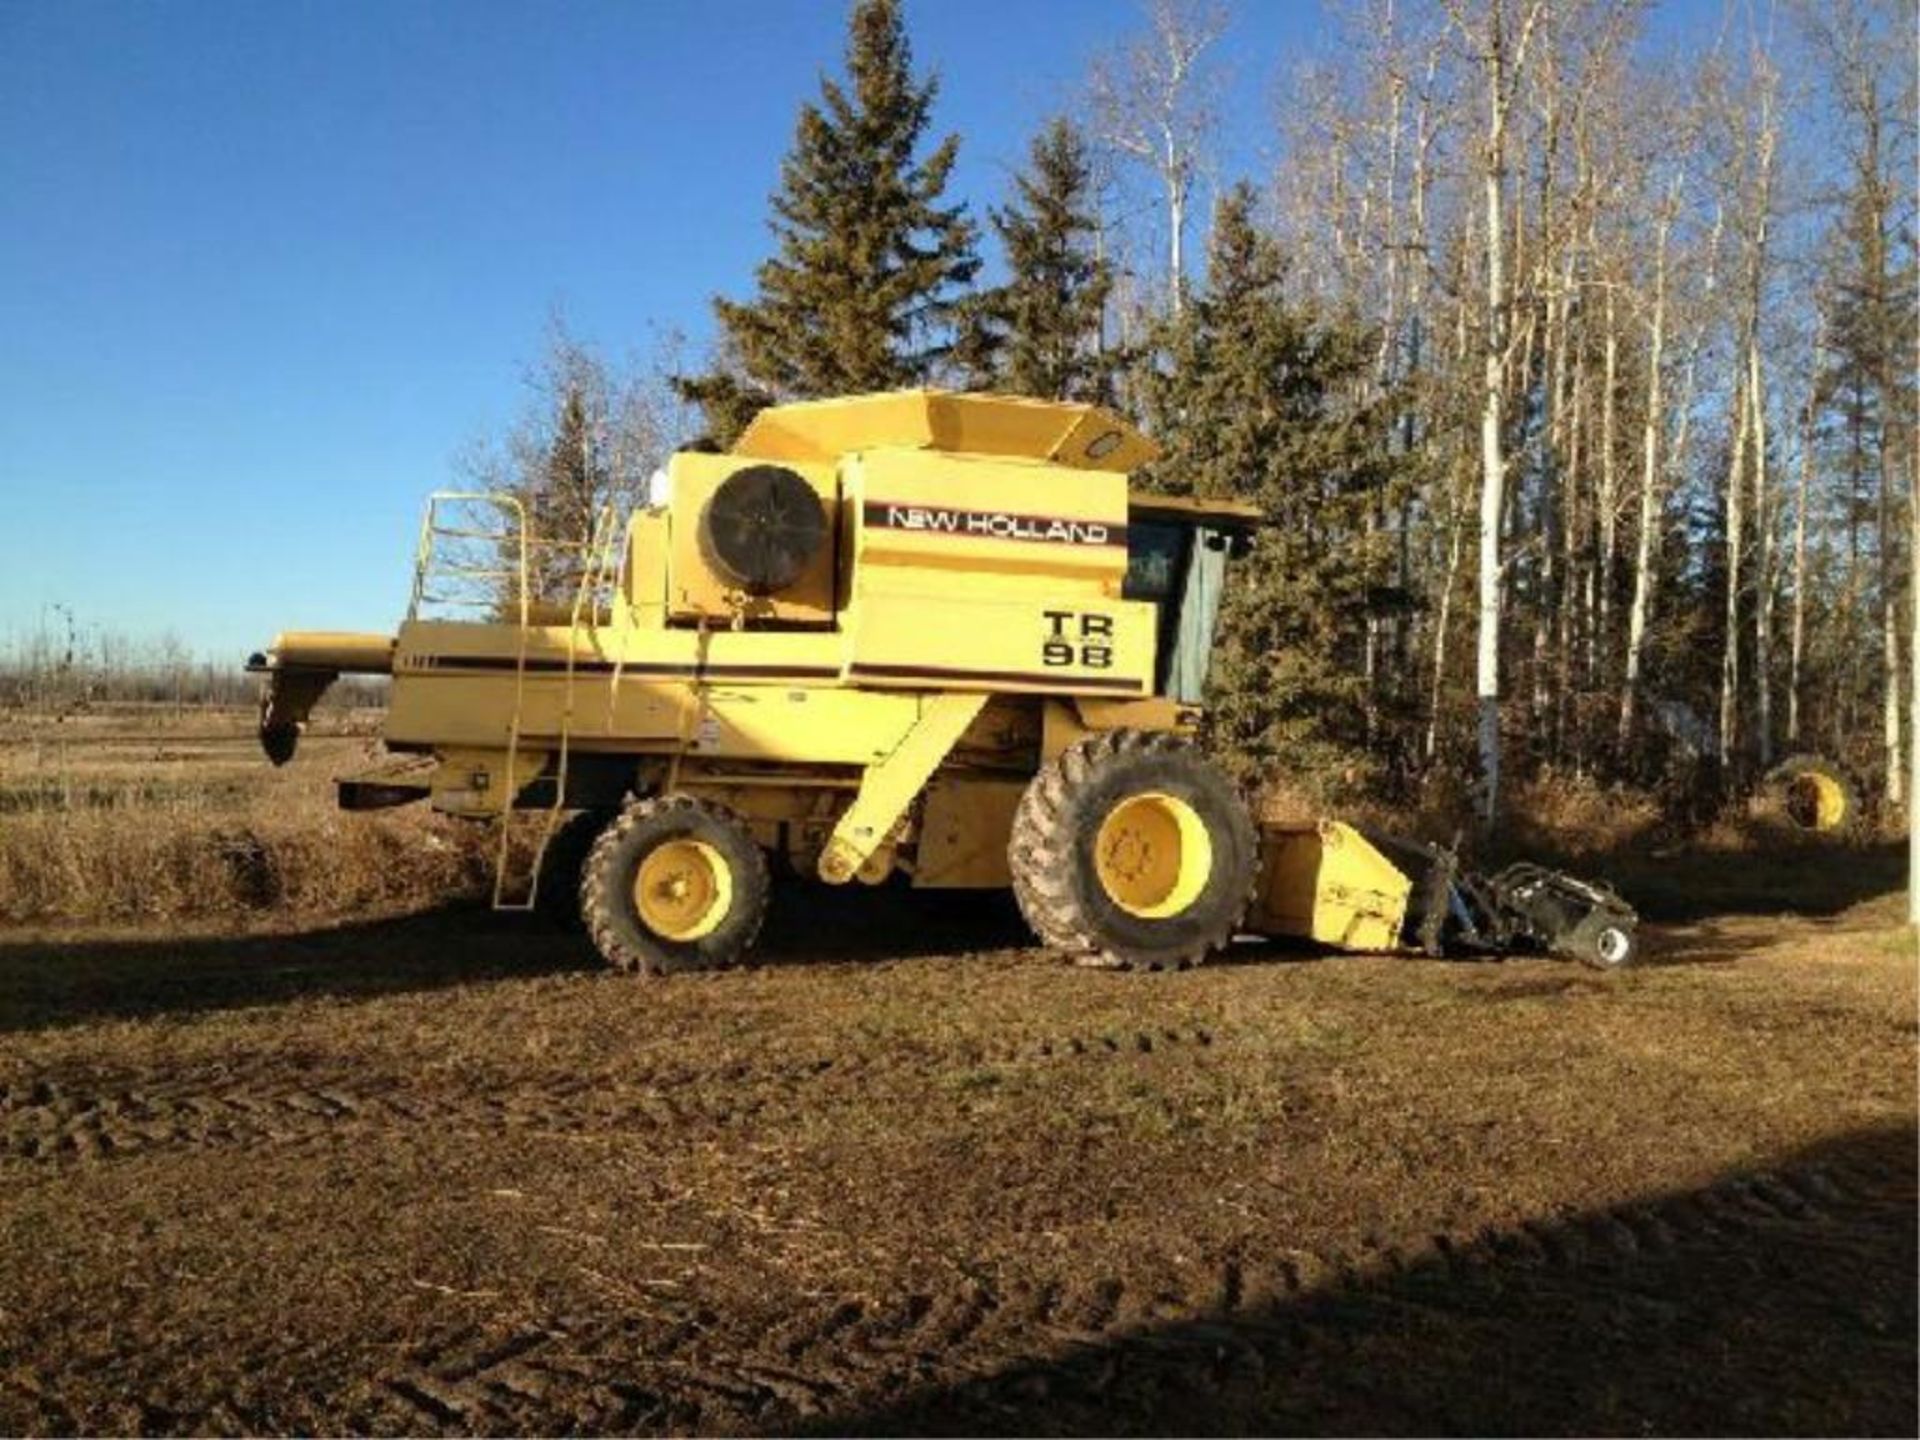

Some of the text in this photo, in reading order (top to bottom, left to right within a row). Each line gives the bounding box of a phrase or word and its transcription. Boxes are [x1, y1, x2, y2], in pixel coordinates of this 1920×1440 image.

[889, 506, 1107, 543] NEW HOLLAND
[1043, 610, 1113, 637] TR
[1043, 643, 1113, 668] 98
